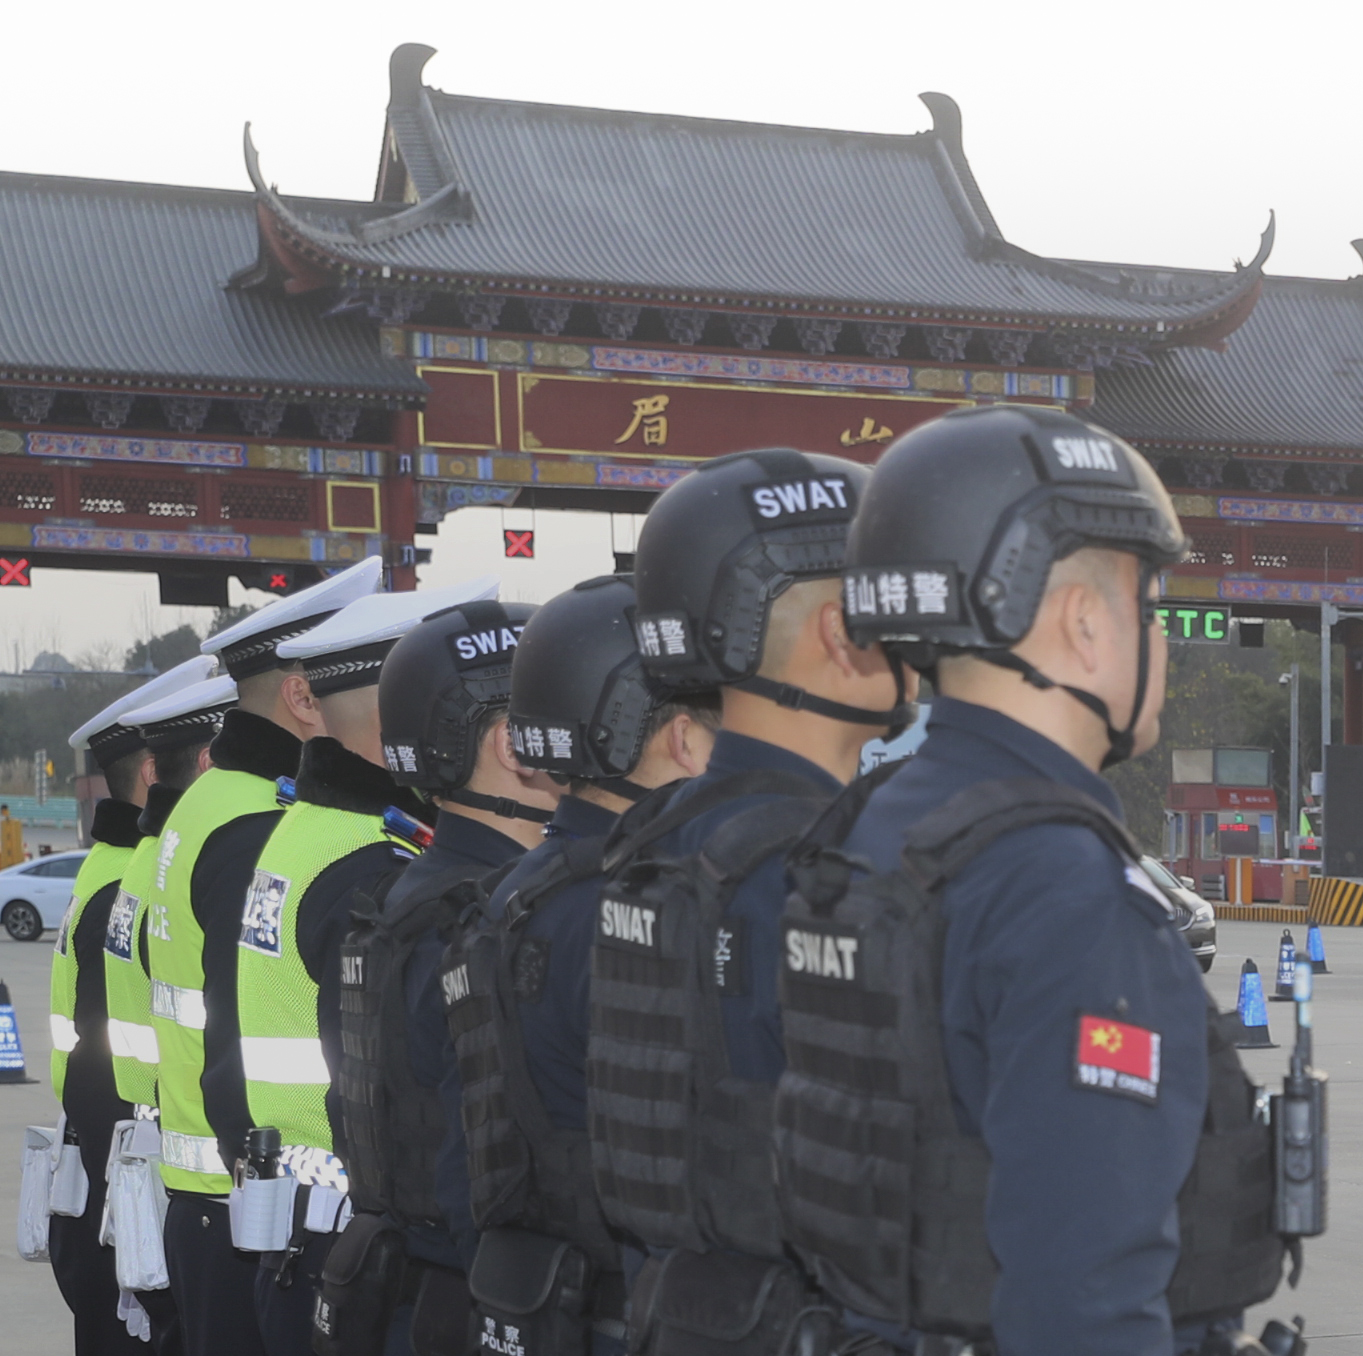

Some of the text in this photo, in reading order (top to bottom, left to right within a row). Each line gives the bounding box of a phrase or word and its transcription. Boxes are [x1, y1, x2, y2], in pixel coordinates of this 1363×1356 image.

[614, 394, 894, 447] 眉山
[1052, 436, 1118, 472] SWAT
[753, 479, 847, 518] SWAT
[636, 619, 686, 657] 特警
[602, 900, 655, 947] SWAT
[786, 928, 857, 981] SWAT
[442, 963, 471, 1006] SWAT
